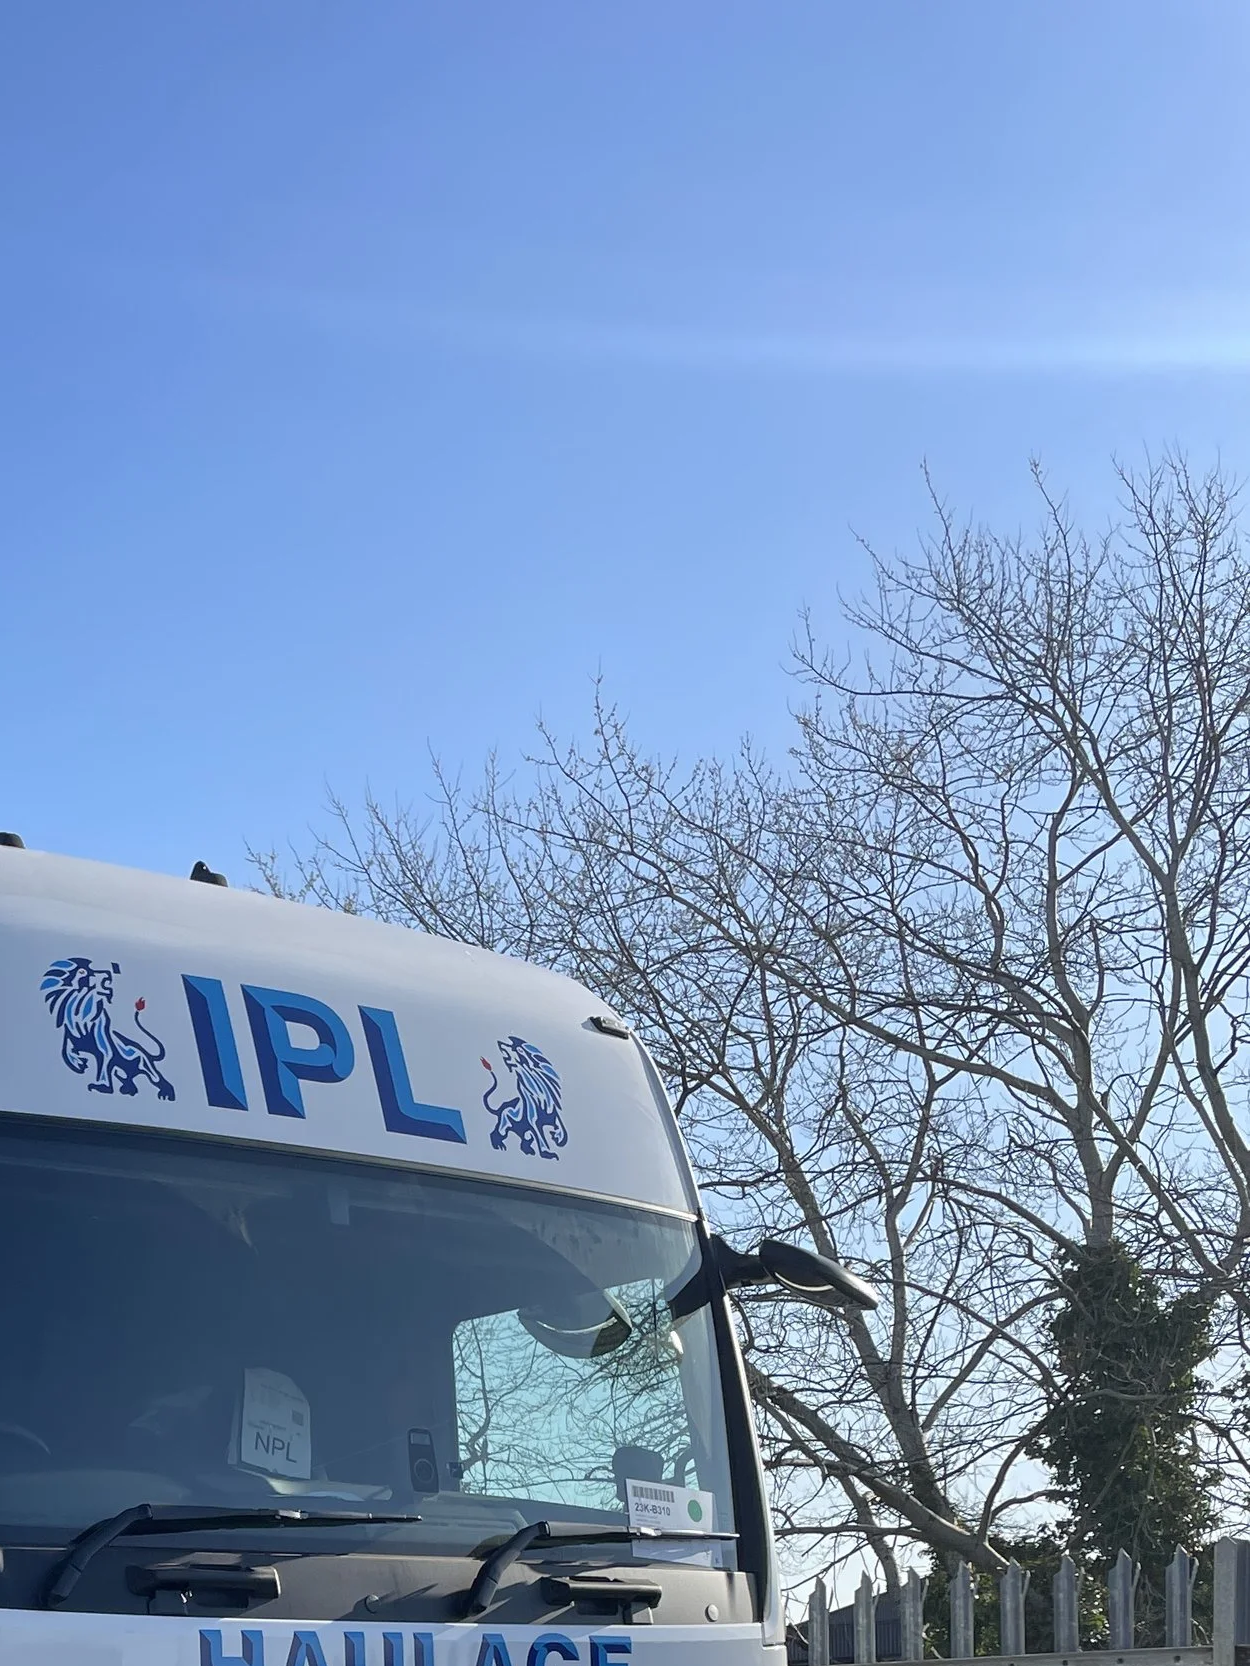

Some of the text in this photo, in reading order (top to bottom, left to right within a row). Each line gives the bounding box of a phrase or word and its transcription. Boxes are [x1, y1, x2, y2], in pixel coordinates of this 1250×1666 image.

[180, 973, 468, 1145] IPL
[254, 1431, 297, 1464] NPL
[634, 1502, 671, 1516] 23K-B310
